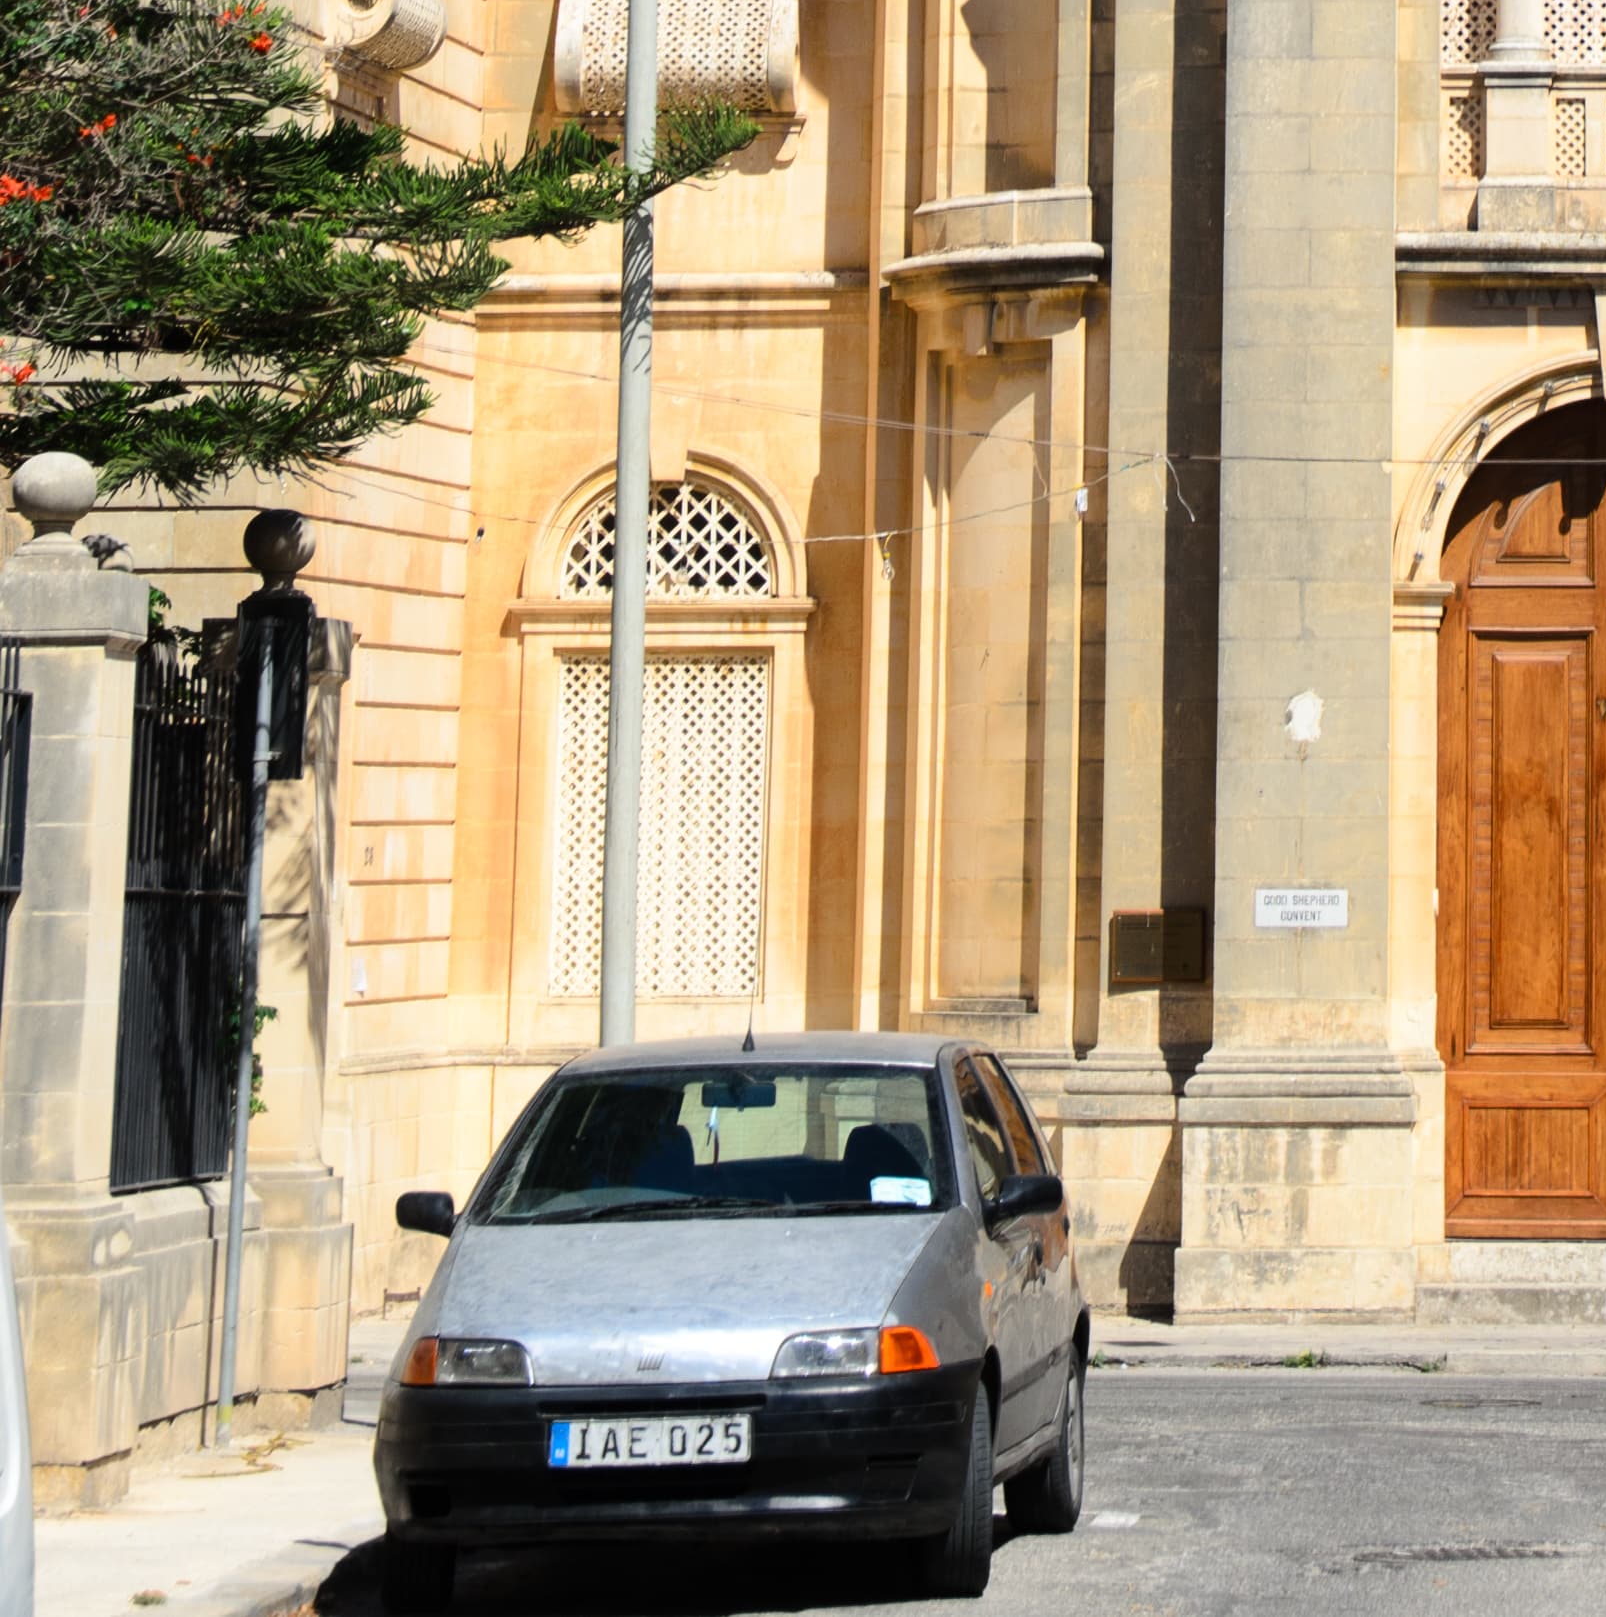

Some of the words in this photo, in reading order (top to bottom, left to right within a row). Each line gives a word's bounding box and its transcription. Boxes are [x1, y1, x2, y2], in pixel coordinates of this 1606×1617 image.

[1263, 894, 1288, 906] GOOD
[1292, 894, 1340, 906] SHEPHERD
[1280, 910, 1322, 921] CONVENT
[575, 1426, 648, 1460] IAE
[669, 1423, 743, 1457] 025
